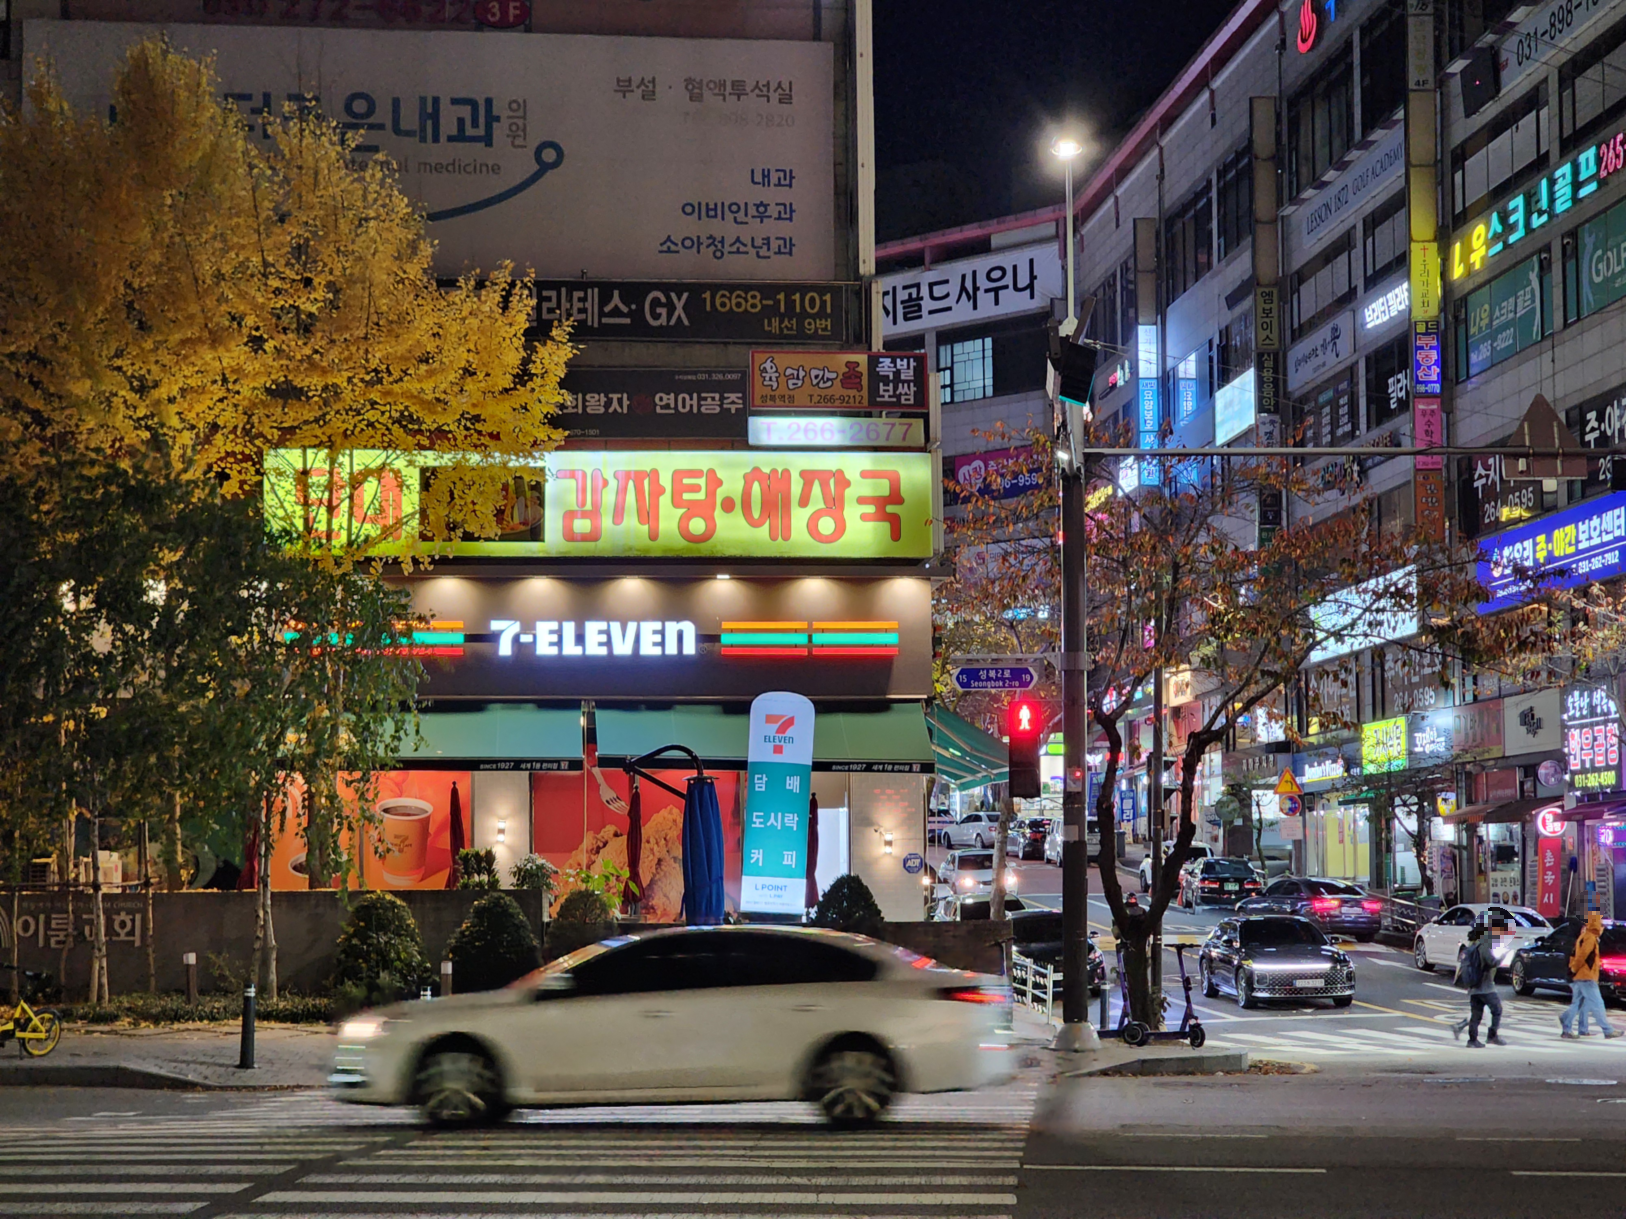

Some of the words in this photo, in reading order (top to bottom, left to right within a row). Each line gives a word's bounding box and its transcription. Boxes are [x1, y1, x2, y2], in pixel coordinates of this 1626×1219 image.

[613, 75, 657, 99] 부설
[683, 76, 793, 105] 혈액투석실
[506, 99, 527, 149] 의원
[417, 158, 502, 175] medicine
[750, 168, 795, 189] 내과
[681, 202, 796, 224] 이비인후과
[1306, 205, 1334, 235] LESSON
[658, 234, 796, 259] 소아청소년과
[644, 291, 690, 327] GX
[701, 290, 832, 315] 1668-1101
[1260, 290, 1276, 347] 엠보이스
[763, 317, 798, 336] 내선
[804, 317, 832, 336] 9번
[1415, 322, 1439, 333] 골드
[875, 357, 917, 381] 족발
[1416, 335, 1440, 381] 부동산
[1261, 352, 1276, 412] 실용음악
[655, 392, 744, 415] 연어공주
[807, 393, 865, 406] T.266-9212
[875, 382, 917, 405] 보쌈
[760, 420, 914, 443] T.266-2677
[1535, 524, 1576, 563] 주·야간
[1577, 506, 1626, 550] 보호센터
[958, 674, 968, 683] 15
[970, 680, 1004, 689] Seongbok
[978, 669, 1012, 680] 성북2로
[1021, 674, 1031, 682] 19
[849, 763, 867, 771] 1927
[751, 811, 799, 831] 도시락
[905, 858, 921, 868] ADT
[761, 883, 788, 892] POINT
